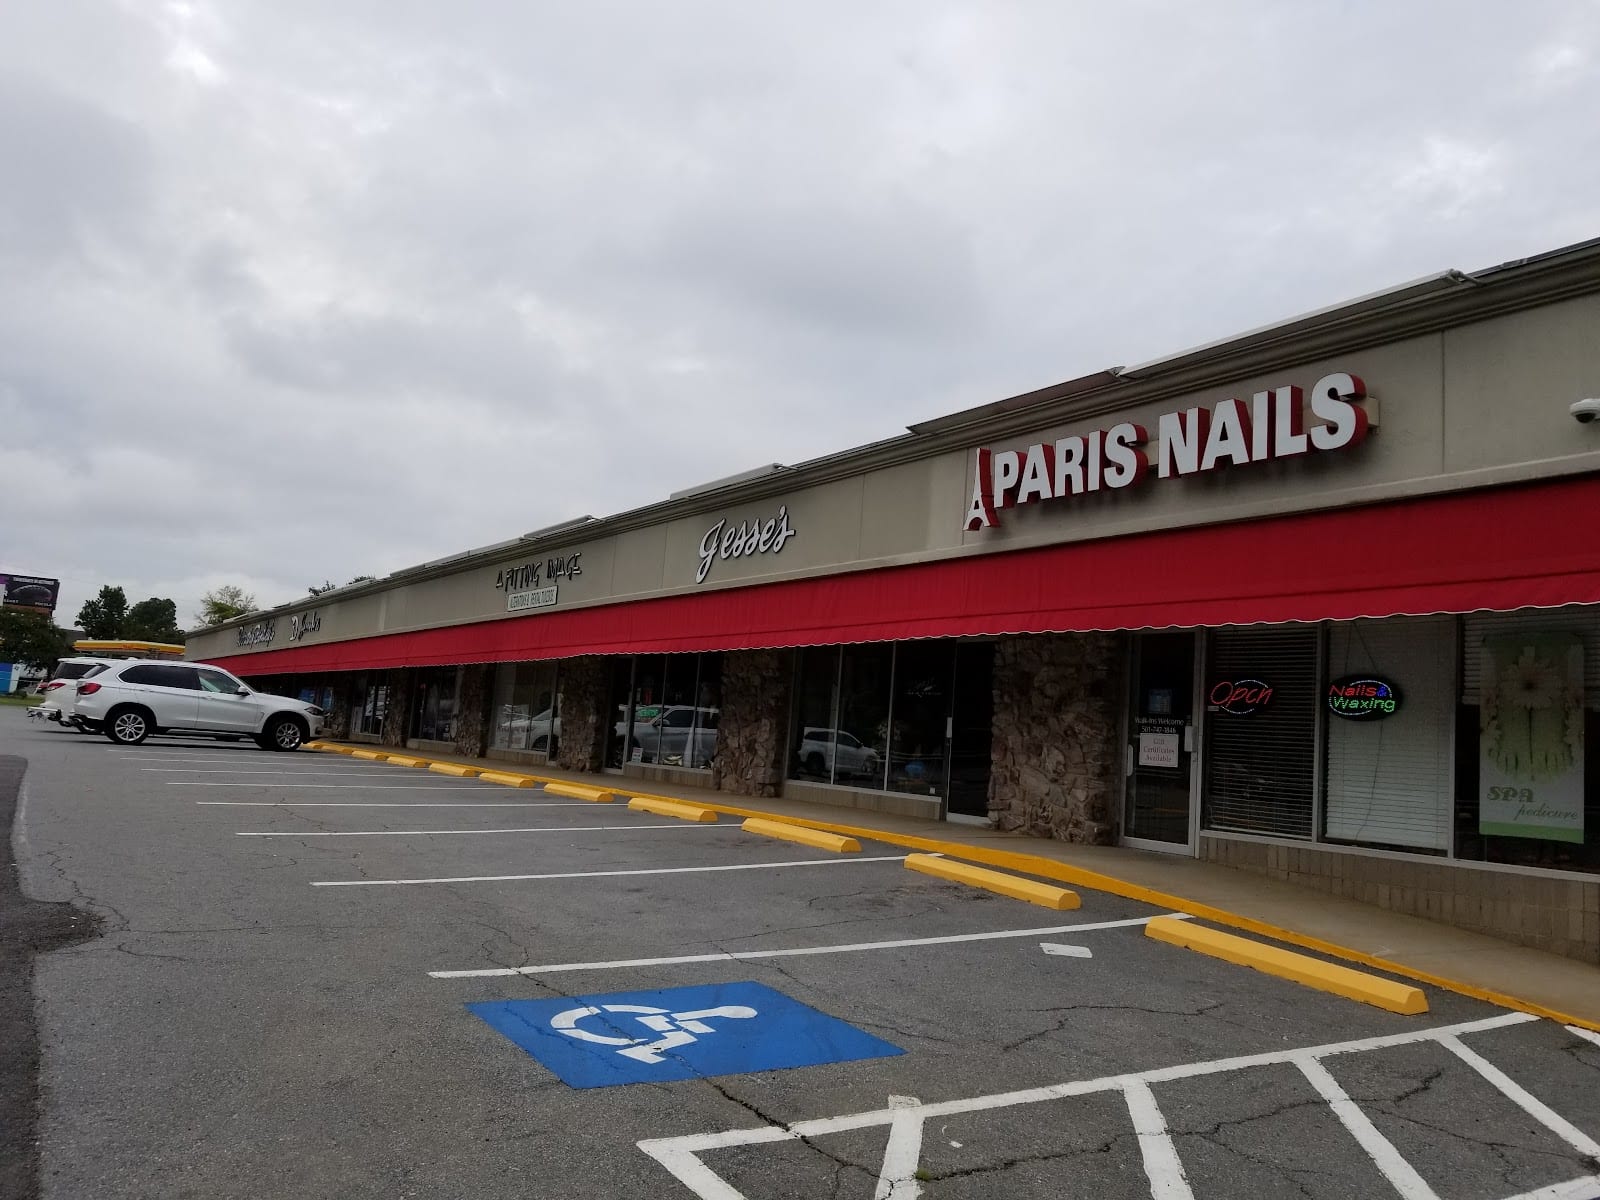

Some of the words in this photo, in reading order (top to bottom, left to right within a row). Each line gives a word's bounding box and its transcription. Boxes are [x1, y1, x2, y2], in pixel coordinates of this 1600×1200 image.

[994, 423, 1146, 509] PARIS
[1158, 372, 1366, 479] NAILS
[695, 505, 795, 584] Jesse's
[1209, 681, 1273, 708] Open
[1329, 684, 1377, 697] Nails
[1332, 696, 1396, 712] Waxing
[1513, 803, 1578, 821] pedicure
